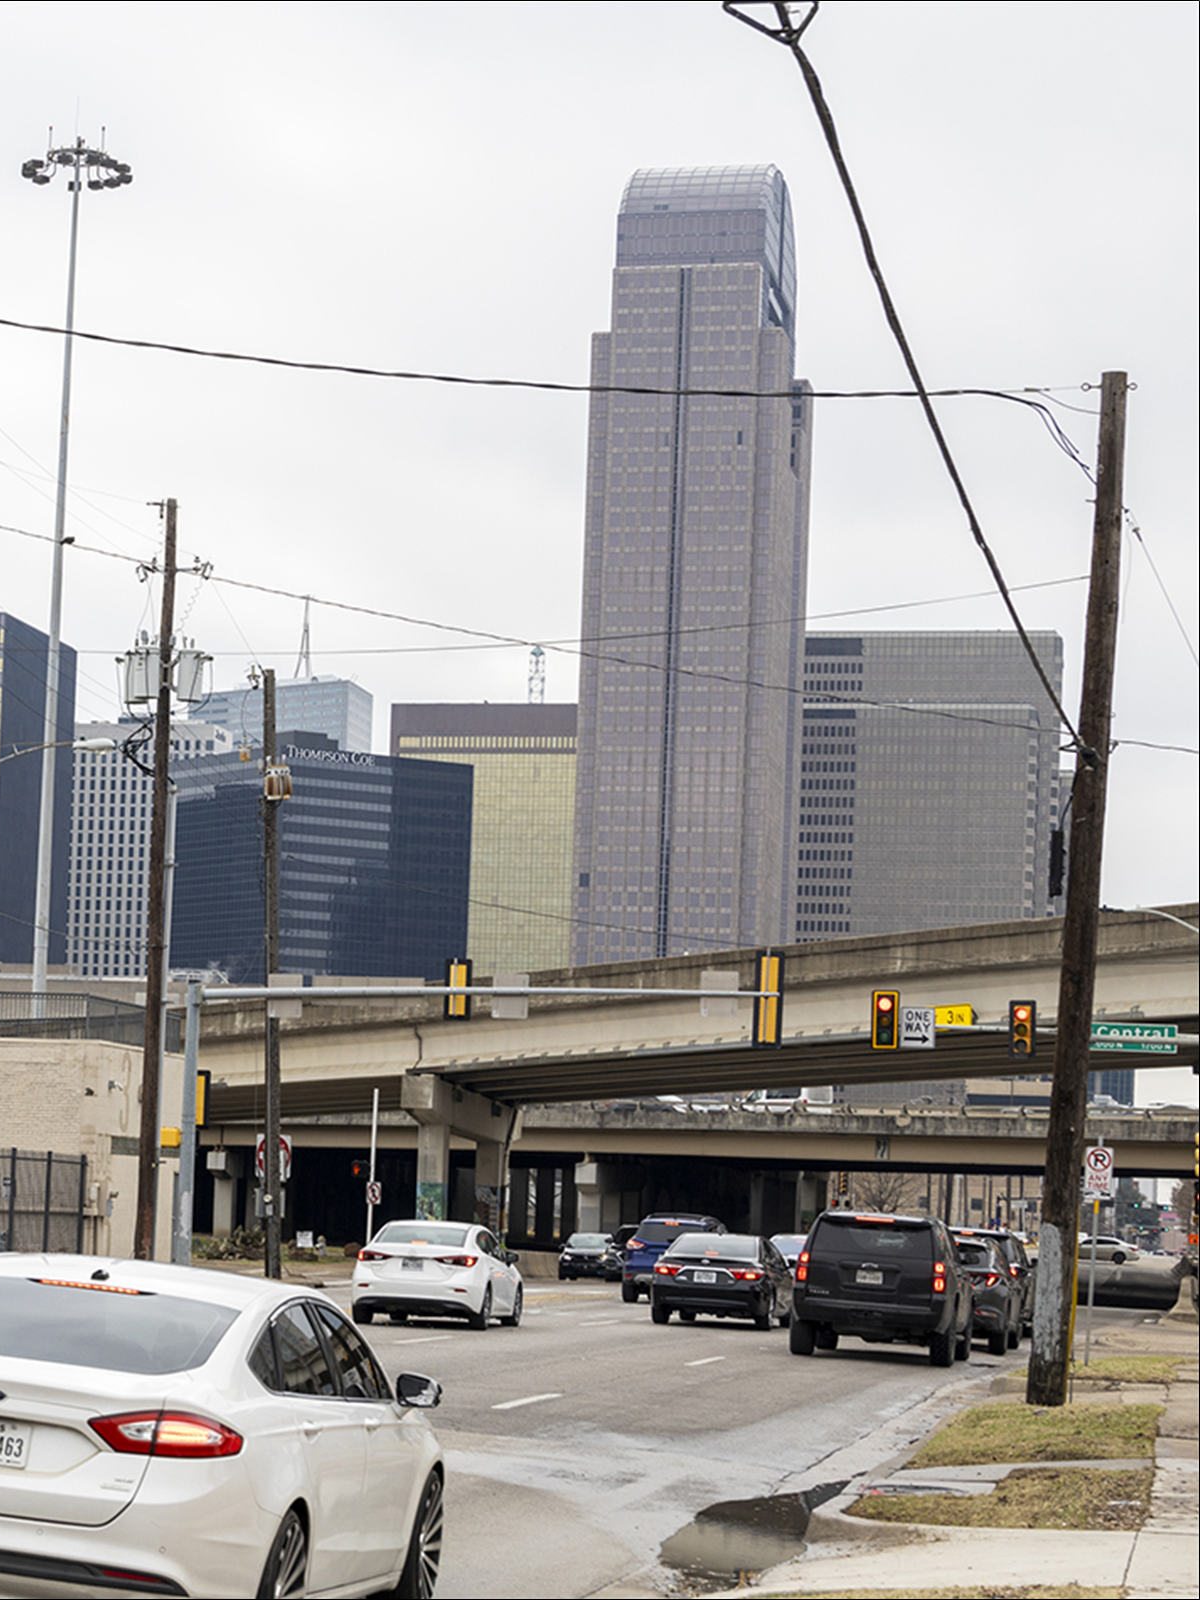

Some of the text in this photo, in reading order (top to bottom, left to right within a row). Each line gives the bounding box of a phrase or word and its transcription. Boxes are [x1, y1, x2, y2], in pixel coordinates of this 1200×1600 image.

[905, 1010, 931, 1022] ONE
[905, 1022, 931, 1032] WAY
[1097, 1026, 1169, 1039] Central
[1087, 1182, 1109, 1190] TIME
